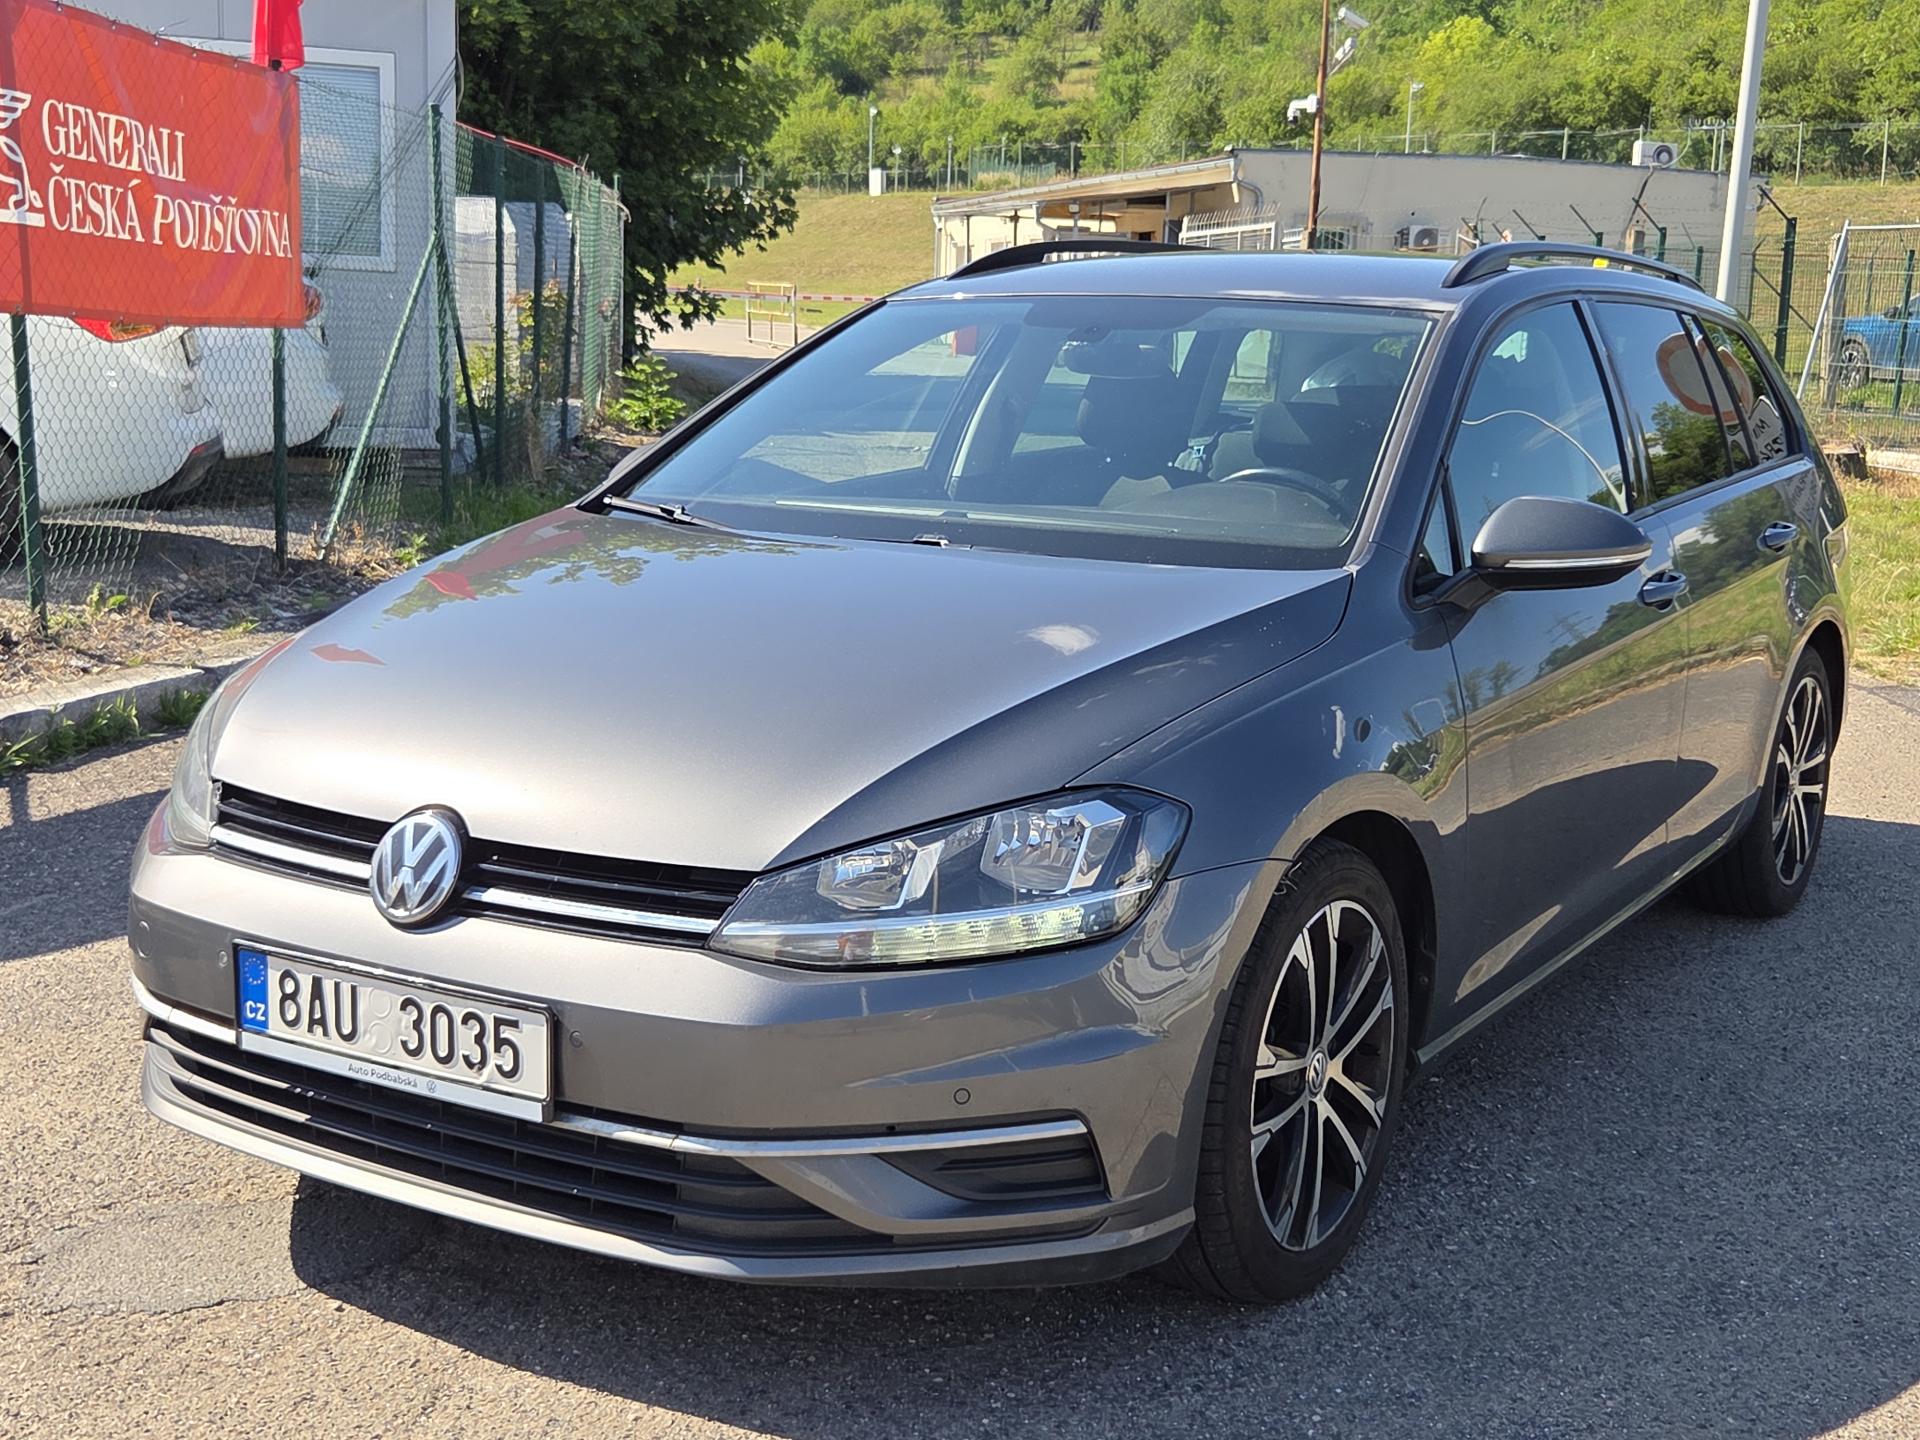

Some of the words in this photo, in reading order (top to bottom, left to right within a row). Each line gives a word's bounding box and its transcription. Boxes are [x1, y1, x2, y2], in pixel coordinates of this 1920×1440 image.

[42, 99, 186, 182] GENERALI
[48, 161, 145, 242] ČESKÁ
[244, 1000, 266, 1022] CZ
[278, 968, 359, 1043] 8AU
[399, 996, 521, 1080] 3035
[347, 1063, 370, 1078] Auto
[371, 1068, 418, 1088] Podbabská
